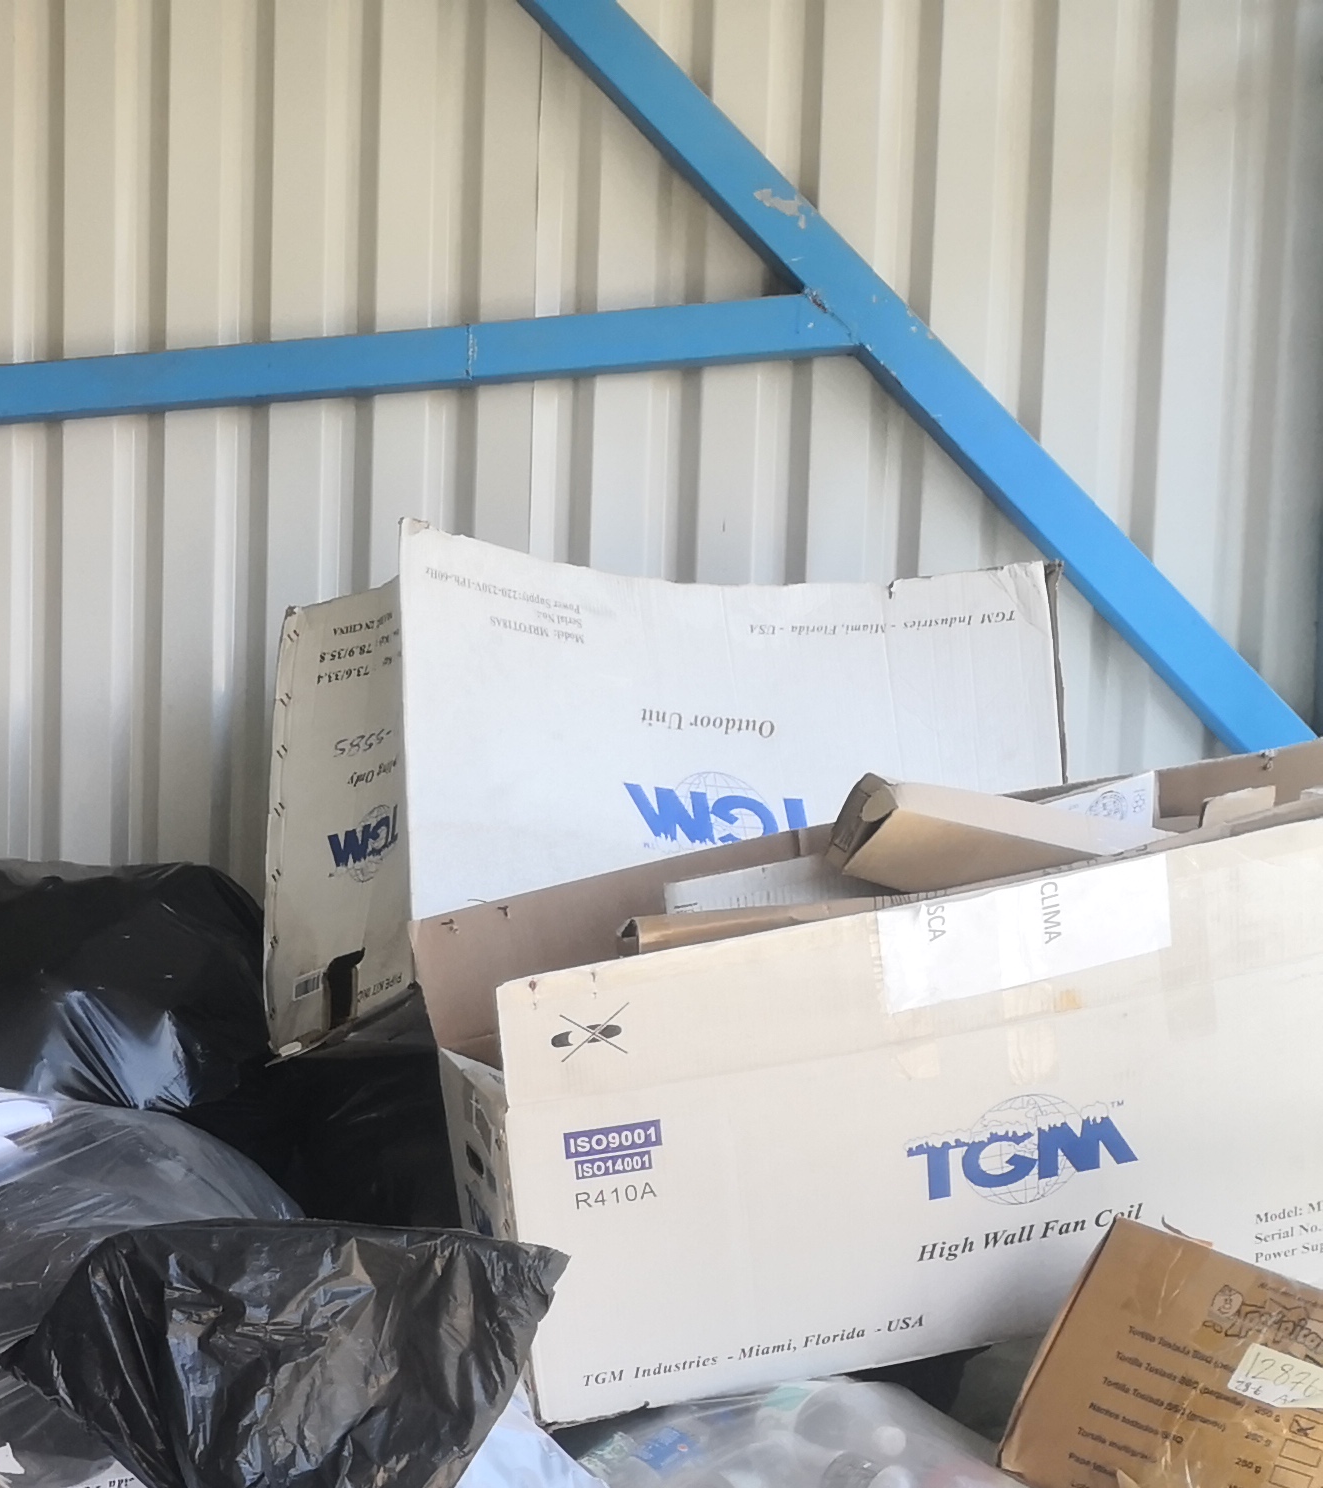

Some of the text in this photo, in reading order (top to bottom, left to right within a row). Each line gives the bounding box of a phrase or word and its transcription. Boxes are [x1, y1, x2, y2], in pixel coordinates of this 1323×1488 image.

[749, 624, 776, 636] USA
[791, 624, 837, 635] Florida
[903, 614, 973, 631] Industries
[980, 610, 1016, 625] TGM
[641, 708, 775, 738] Outdoor Unit
[327, 804, 398, 867] TGM
[1040, 881, 1062, 945] CLIMA
[569, 1126, 657, 1153] ISO9001
[577, 1154, 650, 1177] ISO14001
[907, 1115, 1139, 1200] TGM
[575, 1182, 657, 1210] R410A
[1255, 1206, 1303, 1225] Model:
[917, 1236, 975, 1262] High
[983, 1224, 1035, 1249] Wall
[1040, 1219, 1087, 1240] Fan
[1255, 1227, 1294, 1245] Serial
[1255, 1248, 1297, 1263] Power
[582, 1369, 624, 1387] TGM
[633, 1353, 718, 1380] Industries
[738, 1338, 797, 1361] Miami,
[802, 1327, 866, 1349] Florida
[887, 1314, 926, 1333] USA
